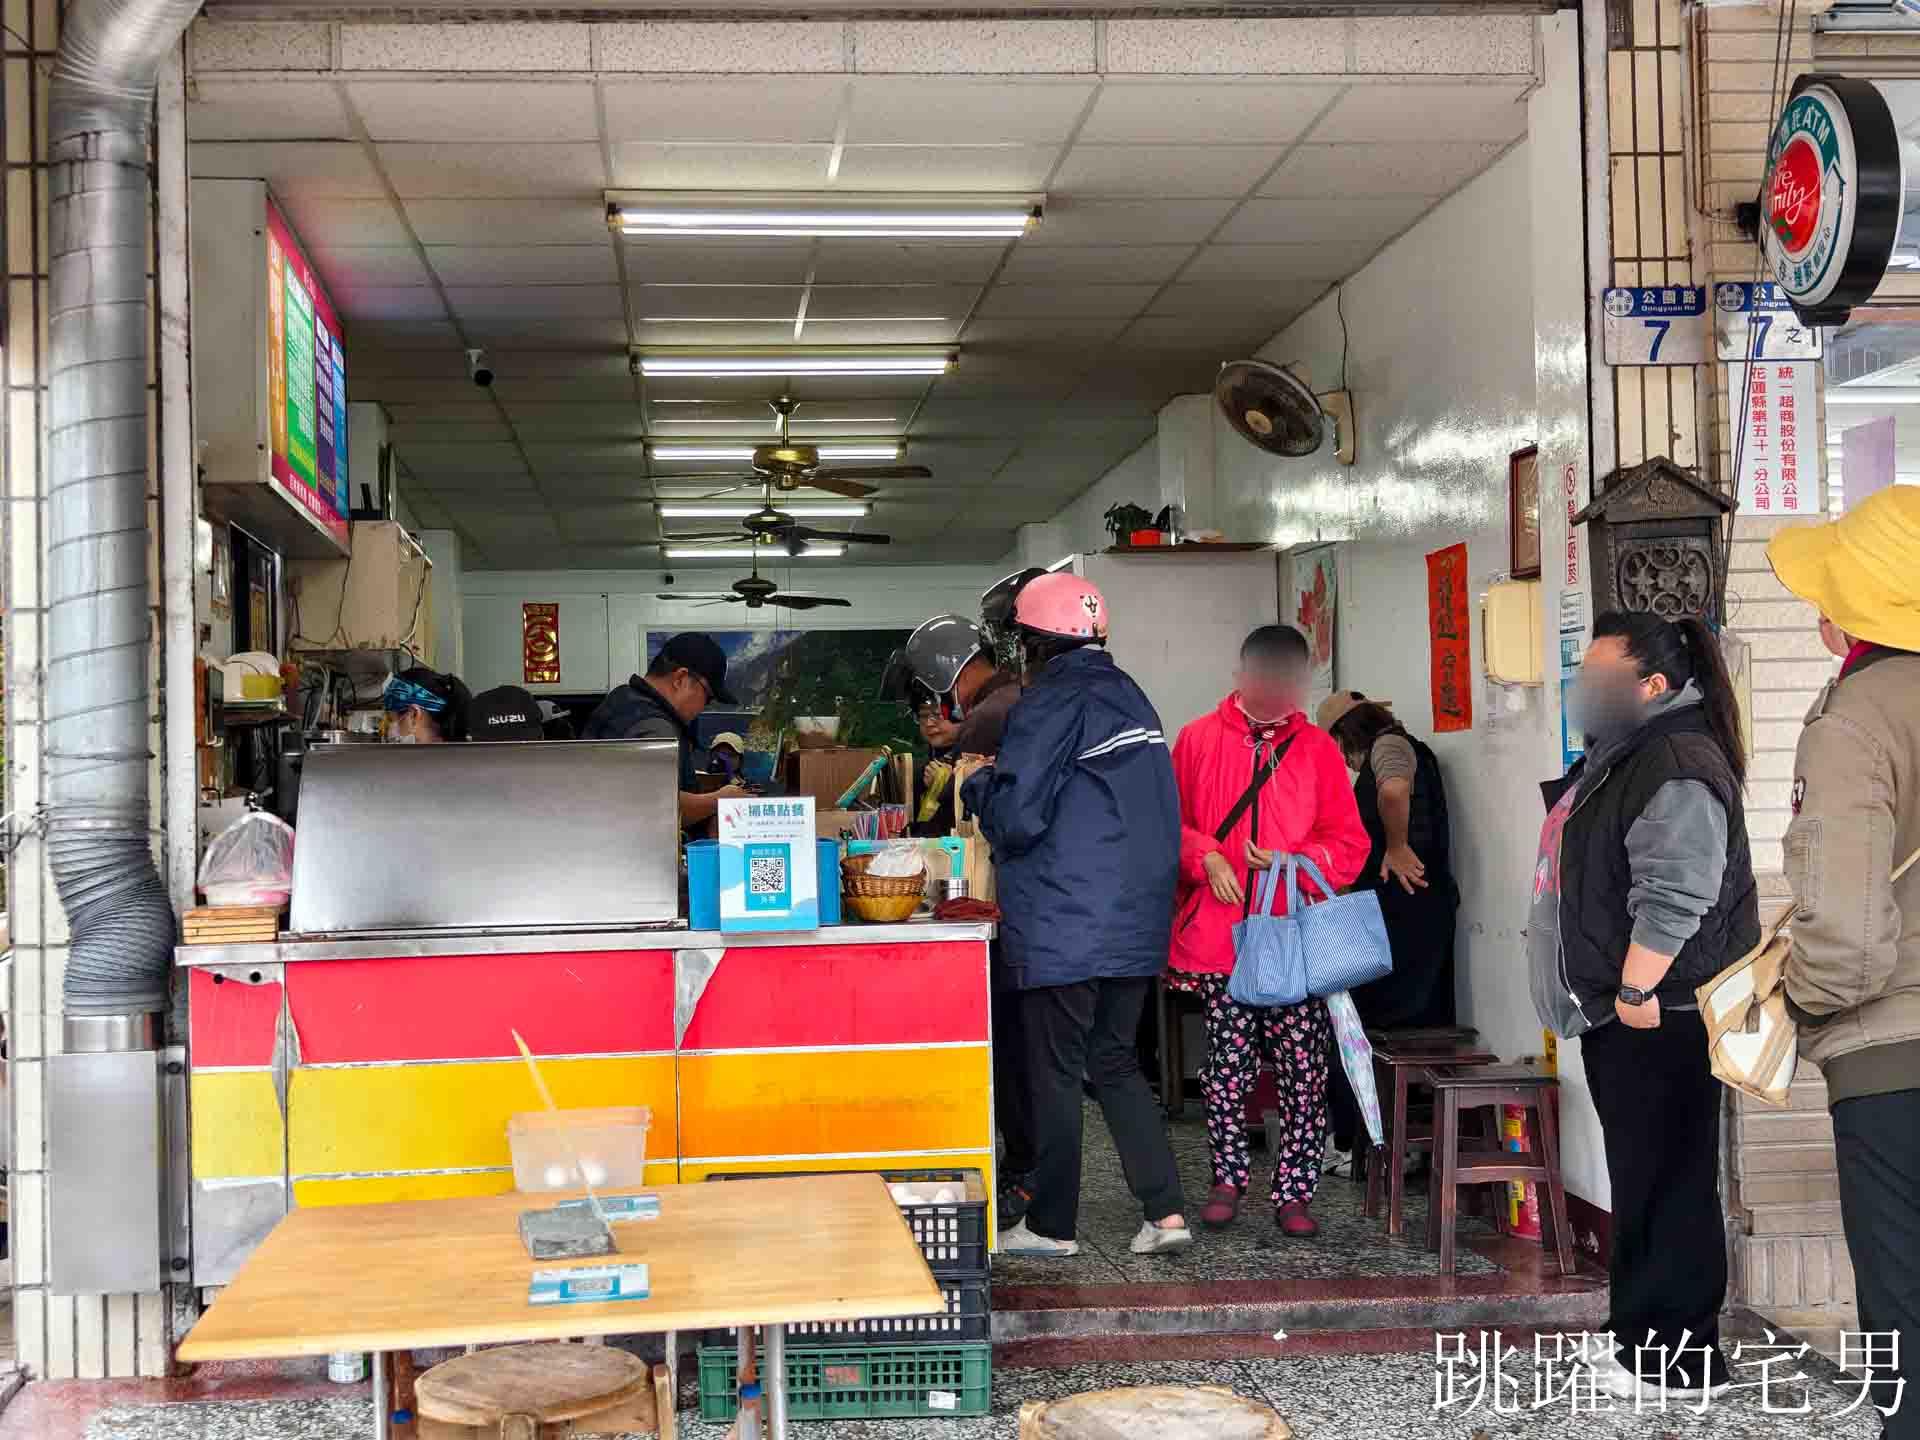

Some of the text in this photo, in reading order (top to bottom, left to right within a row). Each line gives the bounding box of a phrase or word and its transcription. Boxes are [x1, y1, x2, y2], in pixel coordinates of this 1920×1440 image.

[1802, 105, 1831, 144] ATM
[1642, 290, 1696, 304] 公園路
[1643, 320, 1671, 362] 7
[1777, 366, 1798, 510] 統一超商股份有限公司
[488, 713, 526, 725] ISUZU
